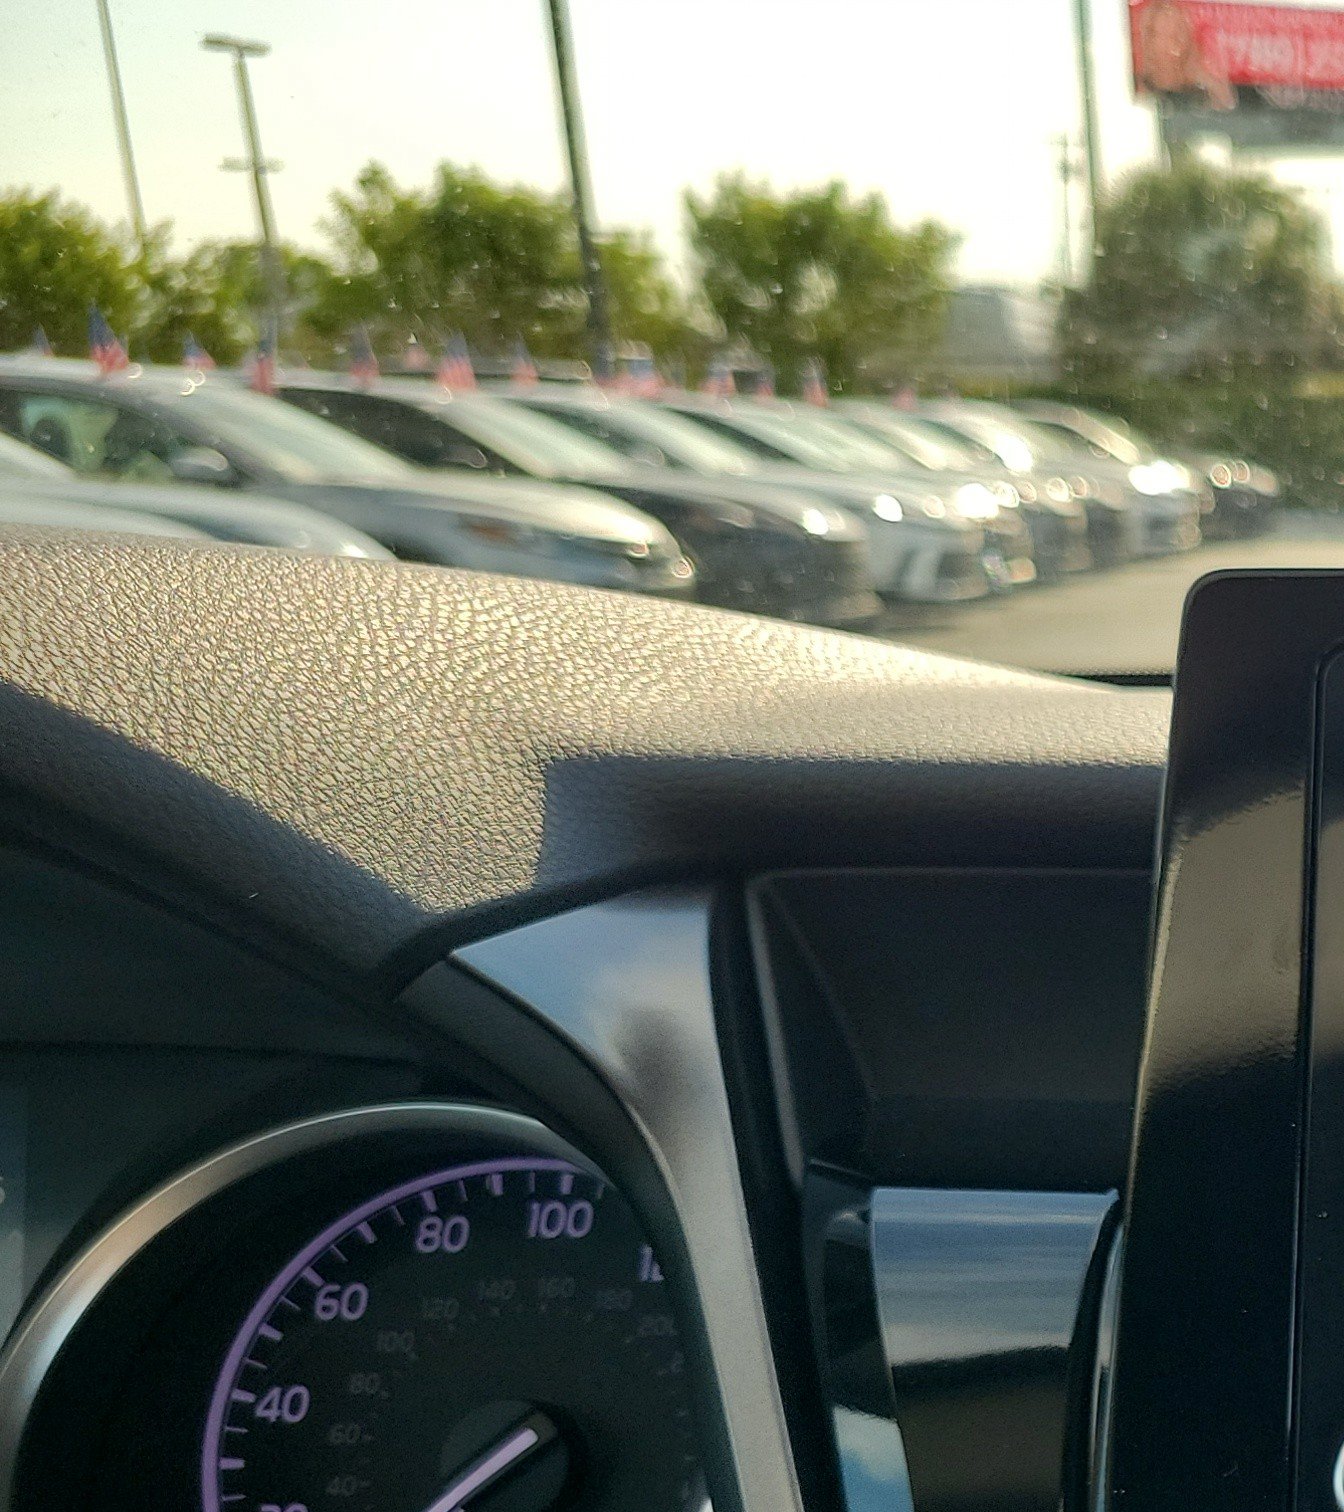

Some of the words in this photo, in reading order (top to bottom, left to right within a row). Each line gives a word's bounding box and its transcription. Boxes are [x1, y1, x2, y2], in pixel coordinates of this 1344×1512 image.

[415, 1216, 470, 1253] 80
[527, 1201, 594, 1238] 100
[313, 1284, 368, 1320] 60
[255, 1386, 310, 1423] 40
[329, 1424, 360, 1443] 60
[326, 1476, 358, 1496] 40
